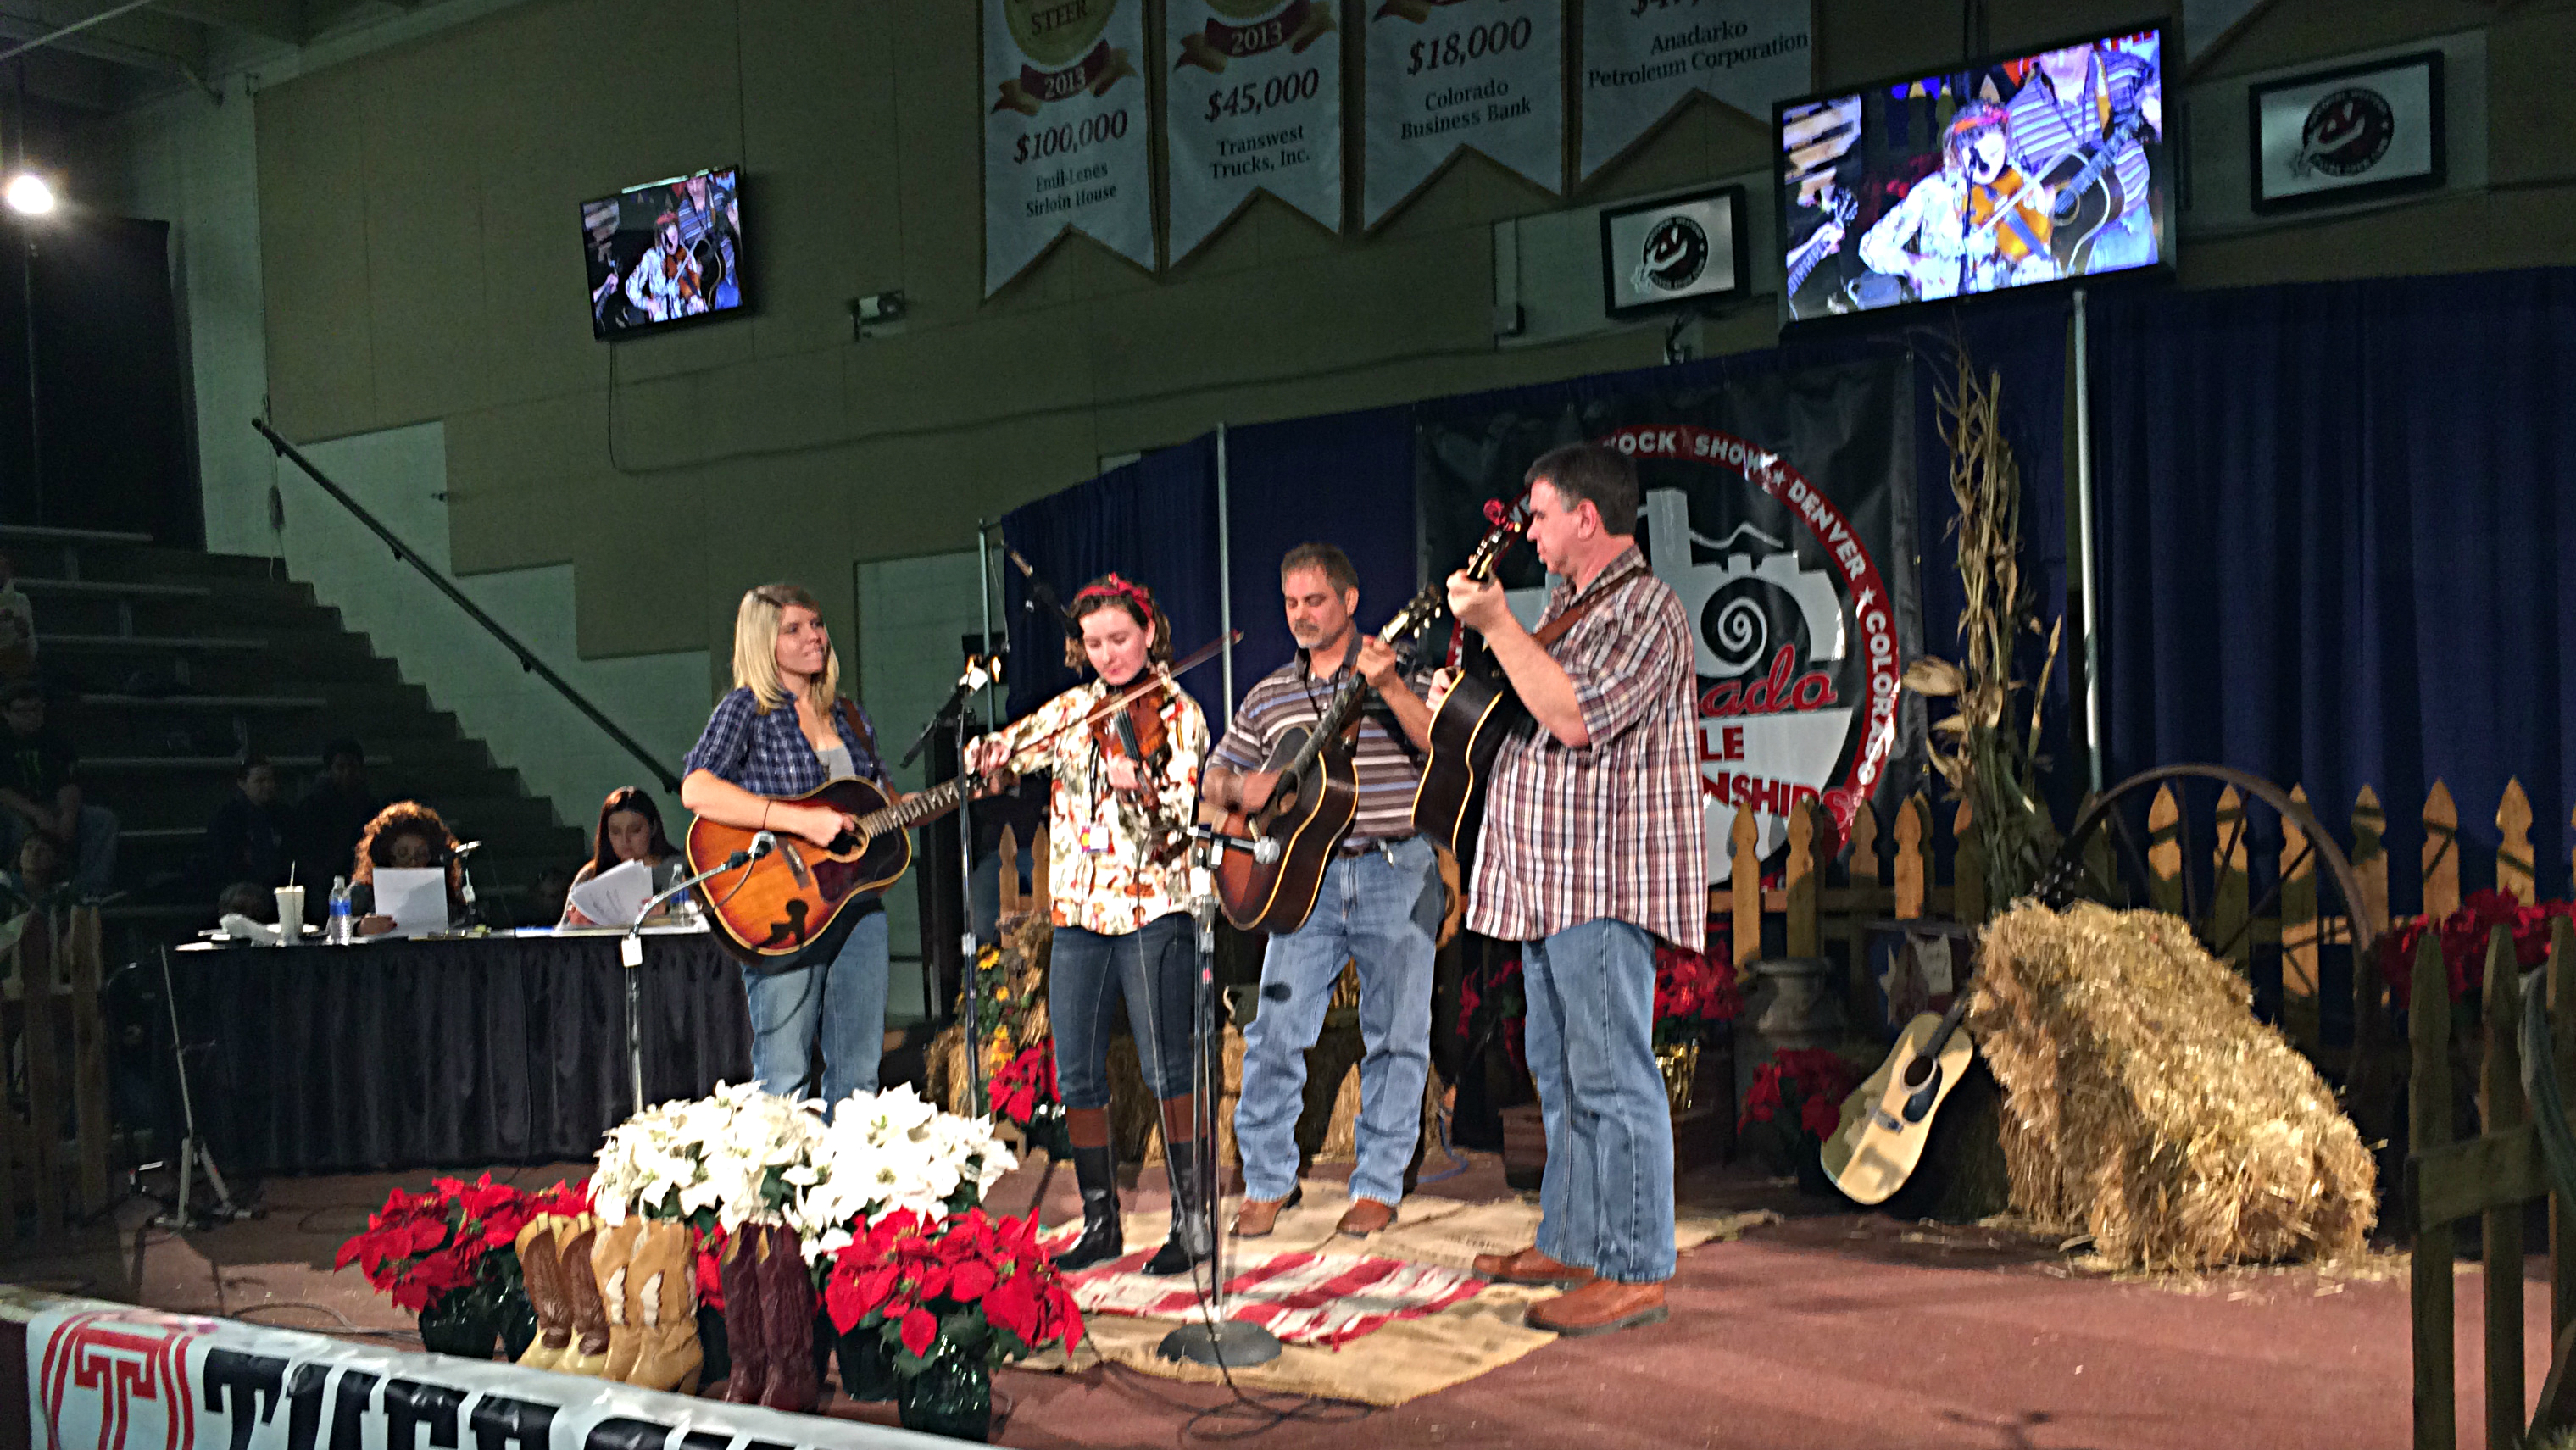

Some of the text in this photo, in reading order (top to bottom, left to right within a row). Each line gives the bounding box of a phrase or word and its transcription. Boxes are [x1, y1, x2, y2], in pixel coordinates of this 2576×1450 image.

[1030, 0, 1088, 36] STEER
[1232, 21, 1282, 53] 2013
[1407, 16, 1532, 75] $18,000
[1651, 20, 1748, 54] Anadarko
[1588, 32, 1809, 88] Petroleum Corporation
[1044, 66, 1086, 99] 2013
[1205, 68, 1319, 122] $45,000
[1425, 78, 1509, 111] Colorado
[1014, 108, 1128, 164] $100,000
[1401, 97, 1532, 140] Business Bank
[1216, 125, 1304, 156] Transwest
[1280, 147, 1310, 167] Inc.
[1026, 184, 1117, 217] Sirloin House
[1603, 430, 1677, 456] OCK
[1788, 477, 1866, 581] DENVER
[1857, 610, 1893, 785] COLORADO
